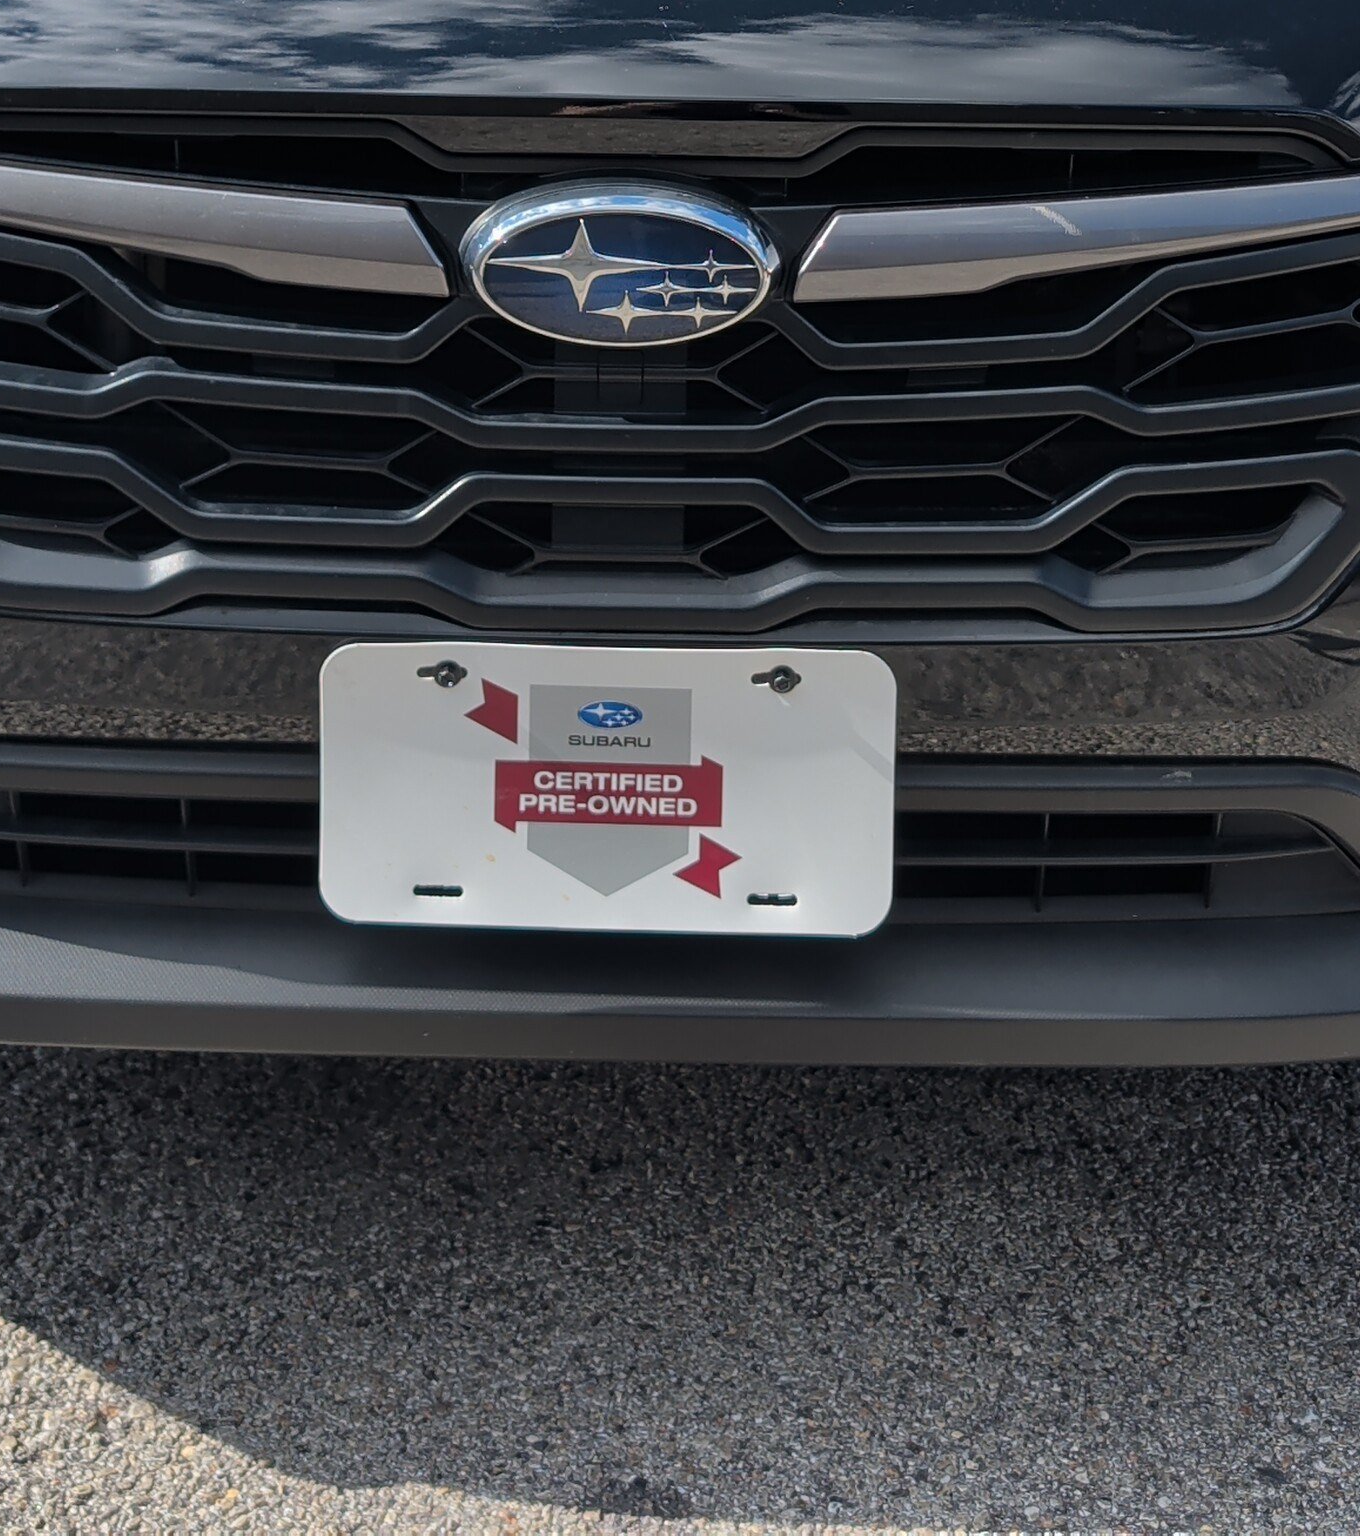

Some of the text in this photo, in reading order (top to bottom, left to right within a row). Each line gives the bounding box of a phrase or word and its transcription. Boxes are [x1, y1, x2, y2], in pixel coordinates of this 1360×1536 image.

[568, 734, 651, 748] SUBARU
[533, 770, 684, 793] CERTIFIED
[518, 793, 698, 817] PRE-OWNED
